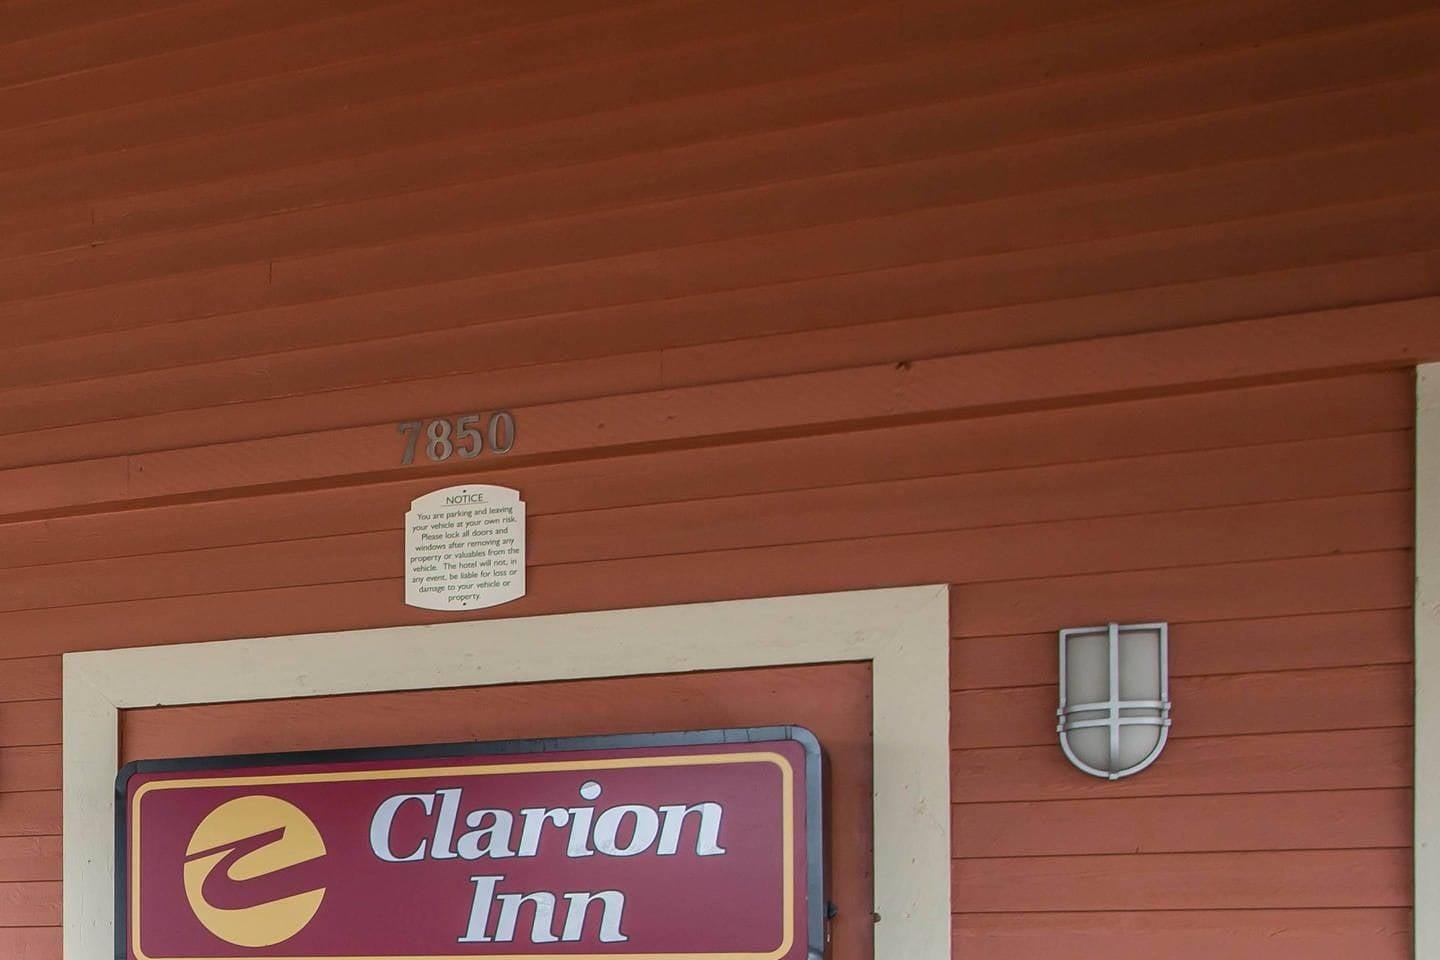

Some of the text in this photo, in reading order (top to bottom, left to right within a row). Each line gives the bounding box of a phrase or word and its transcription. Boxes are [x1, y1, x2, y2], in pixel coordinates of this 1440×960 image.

[398, 410, 516, 466] 7850
[446, 494, 484, 504] NOTICE
[447, 510, 472, 520] parking
[489, 506, 513, 514] leaving
[412, 525, 428, 533] your
[422, 533, 443, 541] Please
[410, 555, 441, 563] property
[460, 571, 478, 579] liable
[419, 584, 445, 593] damage
[457, 583, 474, 591] your
[476, 580, 500, 588] vehicle
[368, 780, 727, 864] Clarion
[456, 874, 629, 945] Inn
